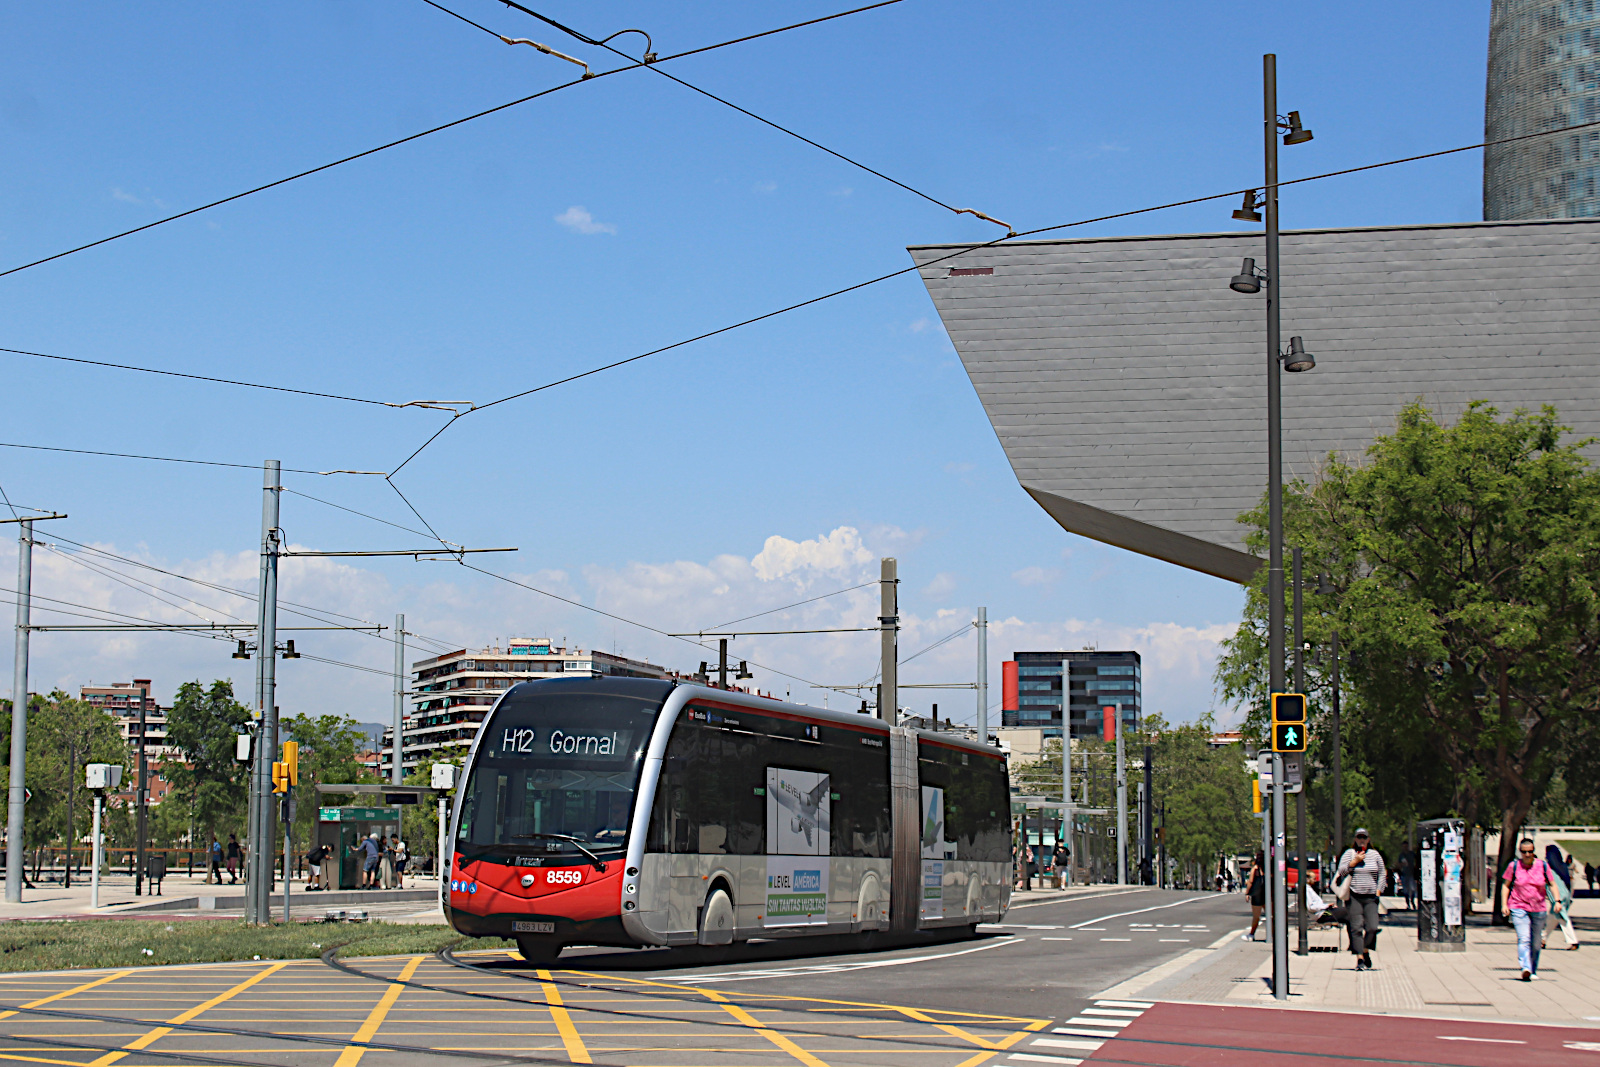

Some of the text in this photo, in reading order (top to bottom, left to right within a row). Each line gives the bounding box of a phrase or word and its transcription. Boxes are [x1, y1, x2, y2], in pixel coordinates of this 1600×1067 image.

[502, 728, 617, 755] H12 Gornal
[546, 870, 582, 884] 8559
[774, 873, 819, 888] LEVEL AMÉRICA
[768, 898, 778, 912] SIN
[779, 898, 801, 912] TANTAS
[516, 922, 553, 931] 4963 LZV
